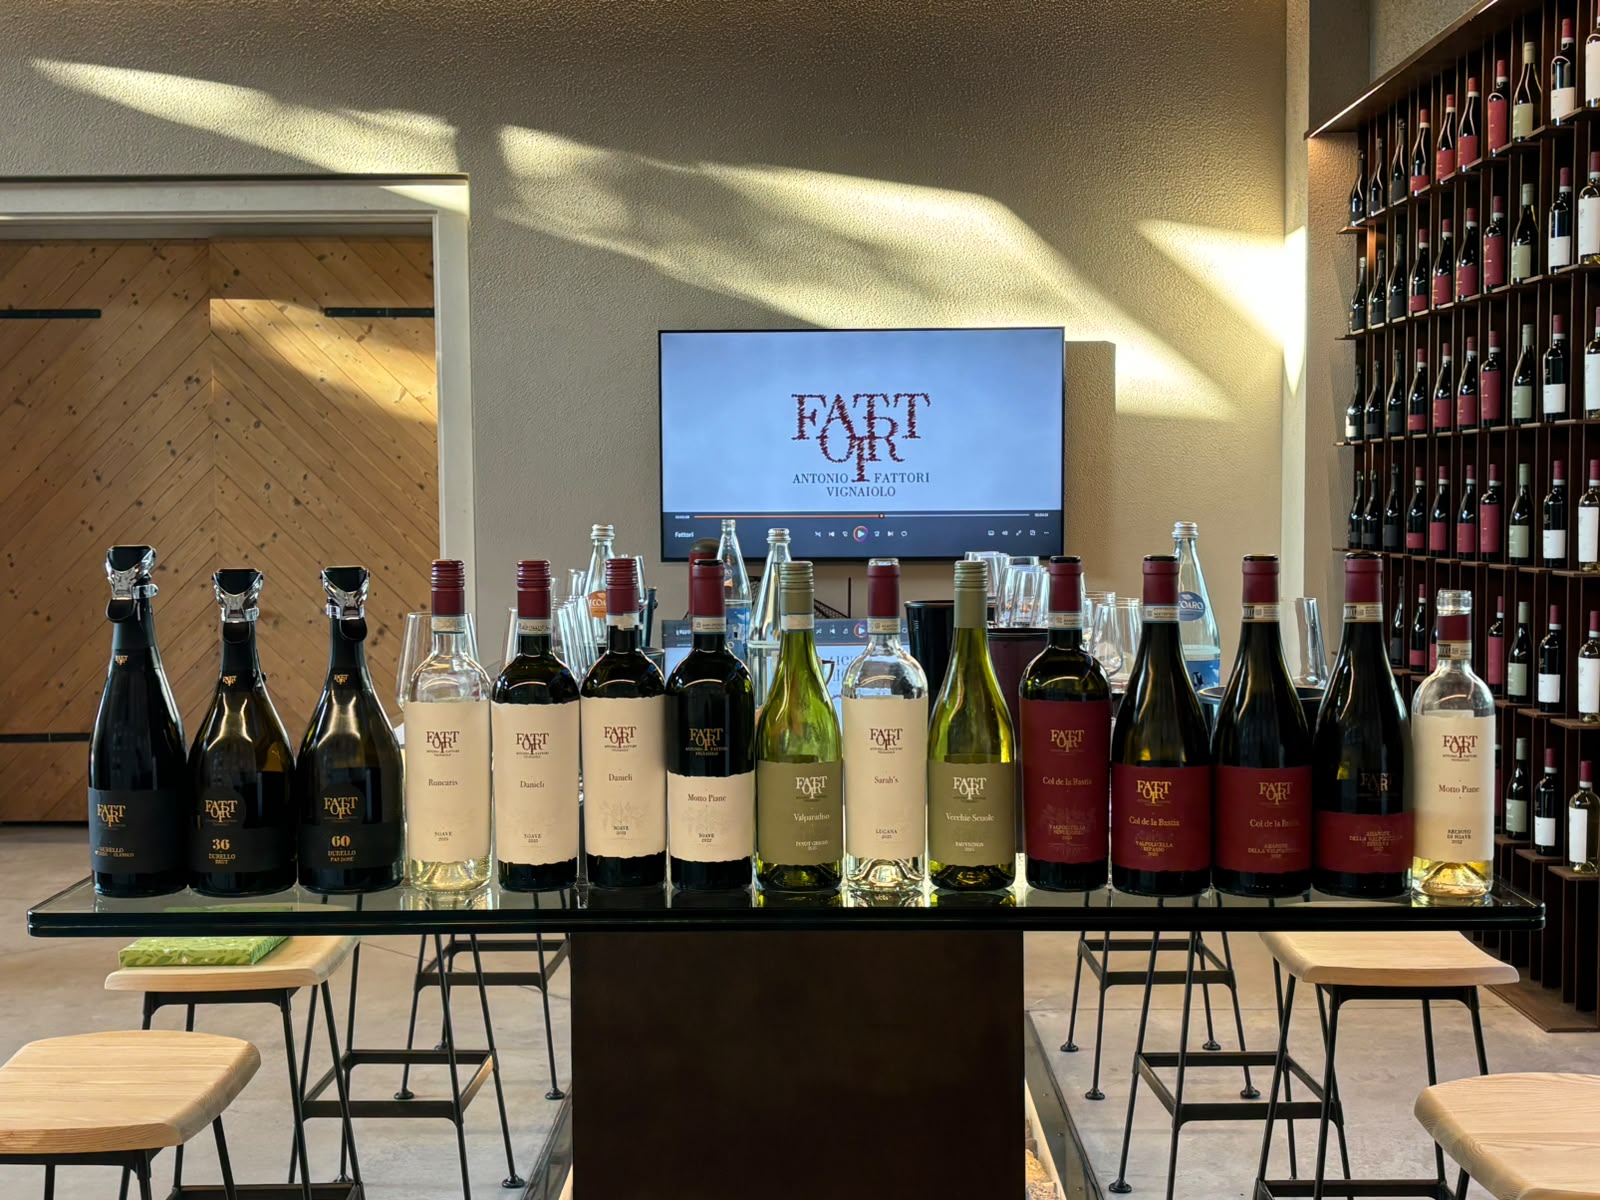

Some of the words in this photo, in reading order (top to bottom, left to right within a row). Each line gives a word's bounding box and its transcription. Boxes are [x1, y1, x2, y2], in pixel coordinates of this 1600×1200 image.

[792, 472, 848, 484] ANTONIO
[874, 472, 930, 484] FATTORI
[826, 486, 896, 497] VIGNAIOLO
[874, 776, 898, 784] Sarah's
[1042, 776, 1054, 784] Col
[1128, 816, 1140, 824] Col
[1250, 819, 1263, 827] Col
[212, 838, 230, 850] 36
[332, 835, 351, 848] 60
